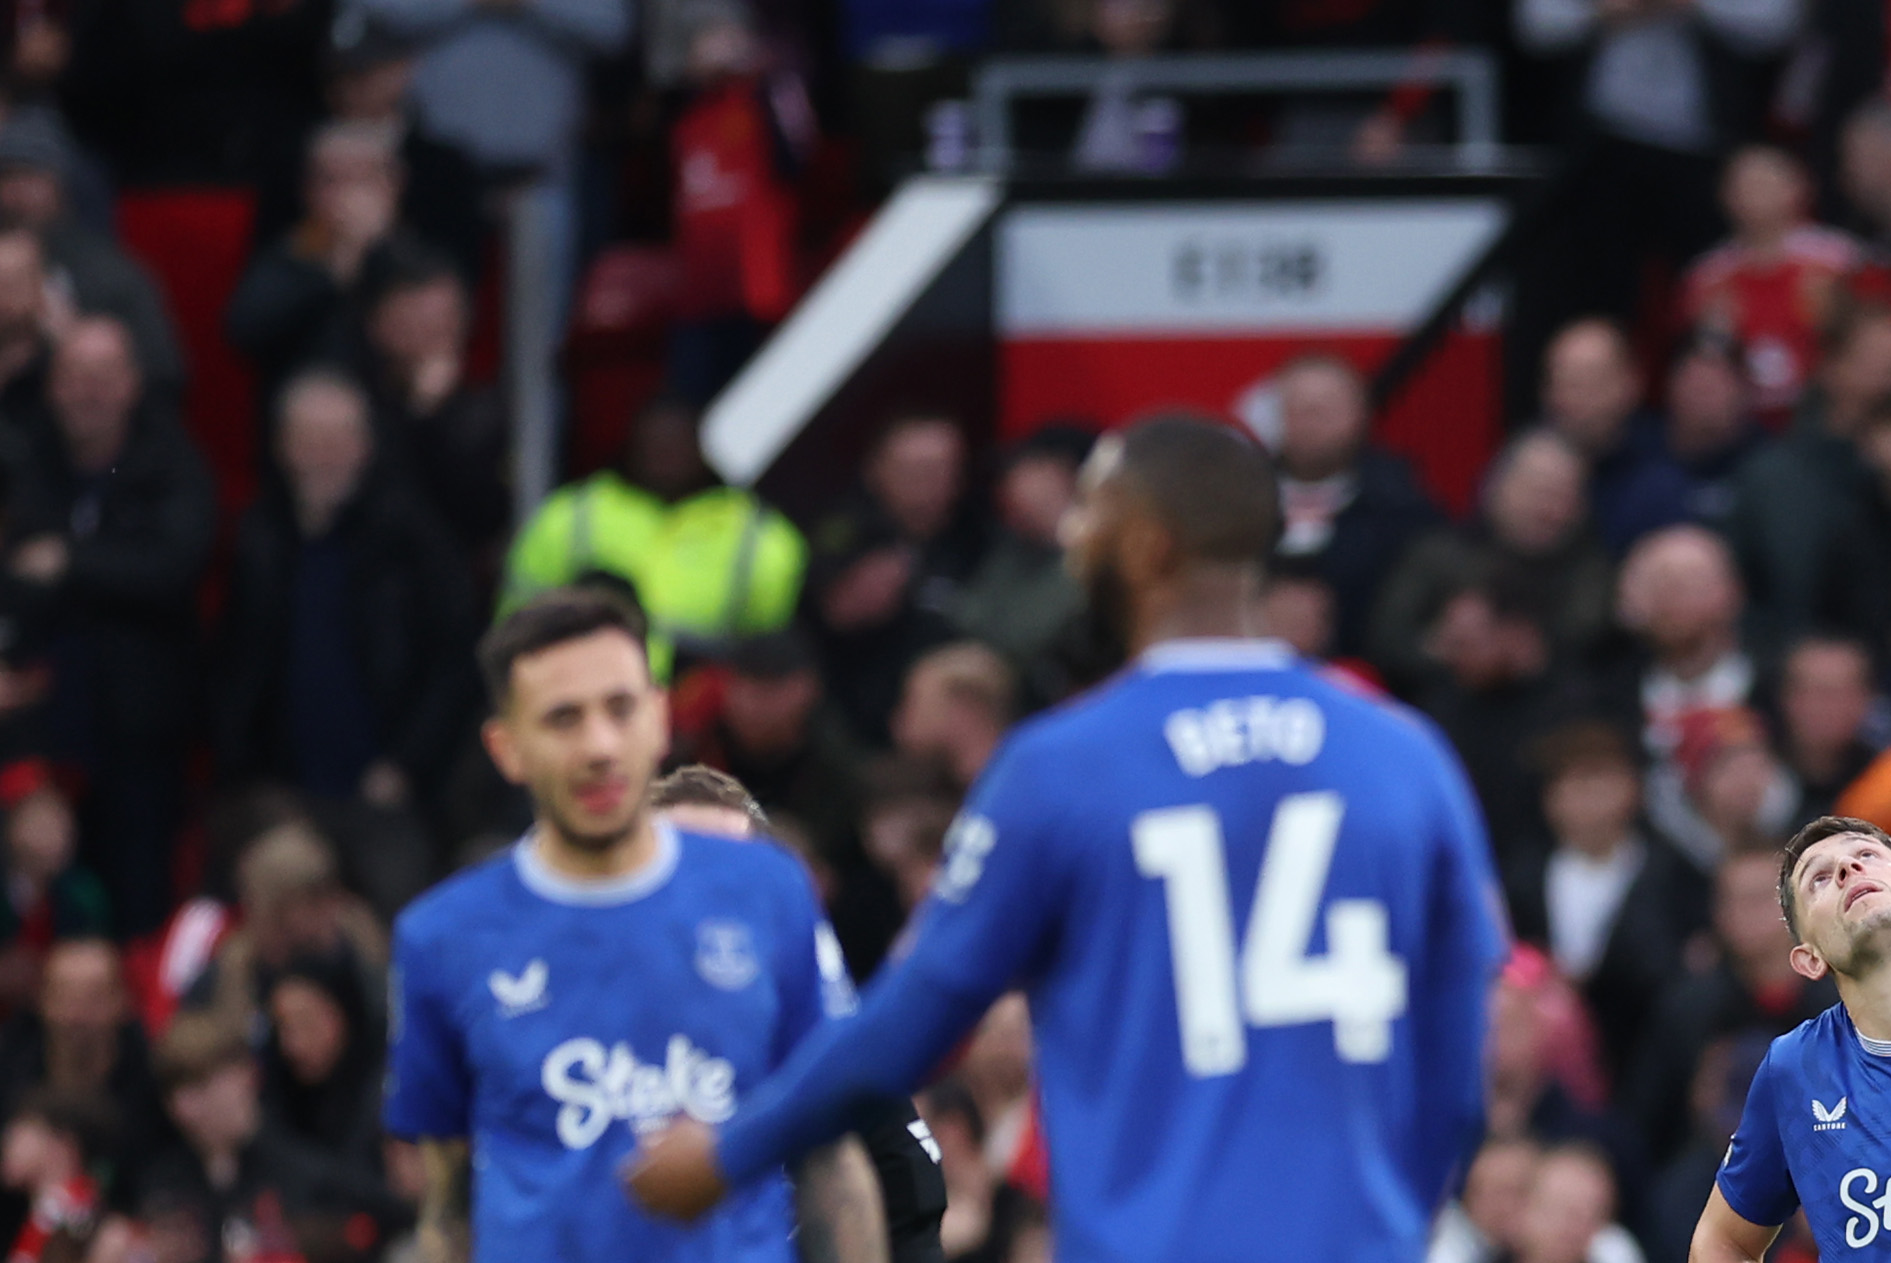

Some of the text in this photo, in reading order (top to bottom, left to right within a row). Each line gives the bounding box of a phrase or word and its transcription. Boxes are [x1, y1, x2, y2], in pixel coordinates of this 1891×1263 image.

[1165, 696, 1326, 777] BETO
[1132, 790, 1407, 1078] 14
[541, 1033, 737, 1150] Stake
